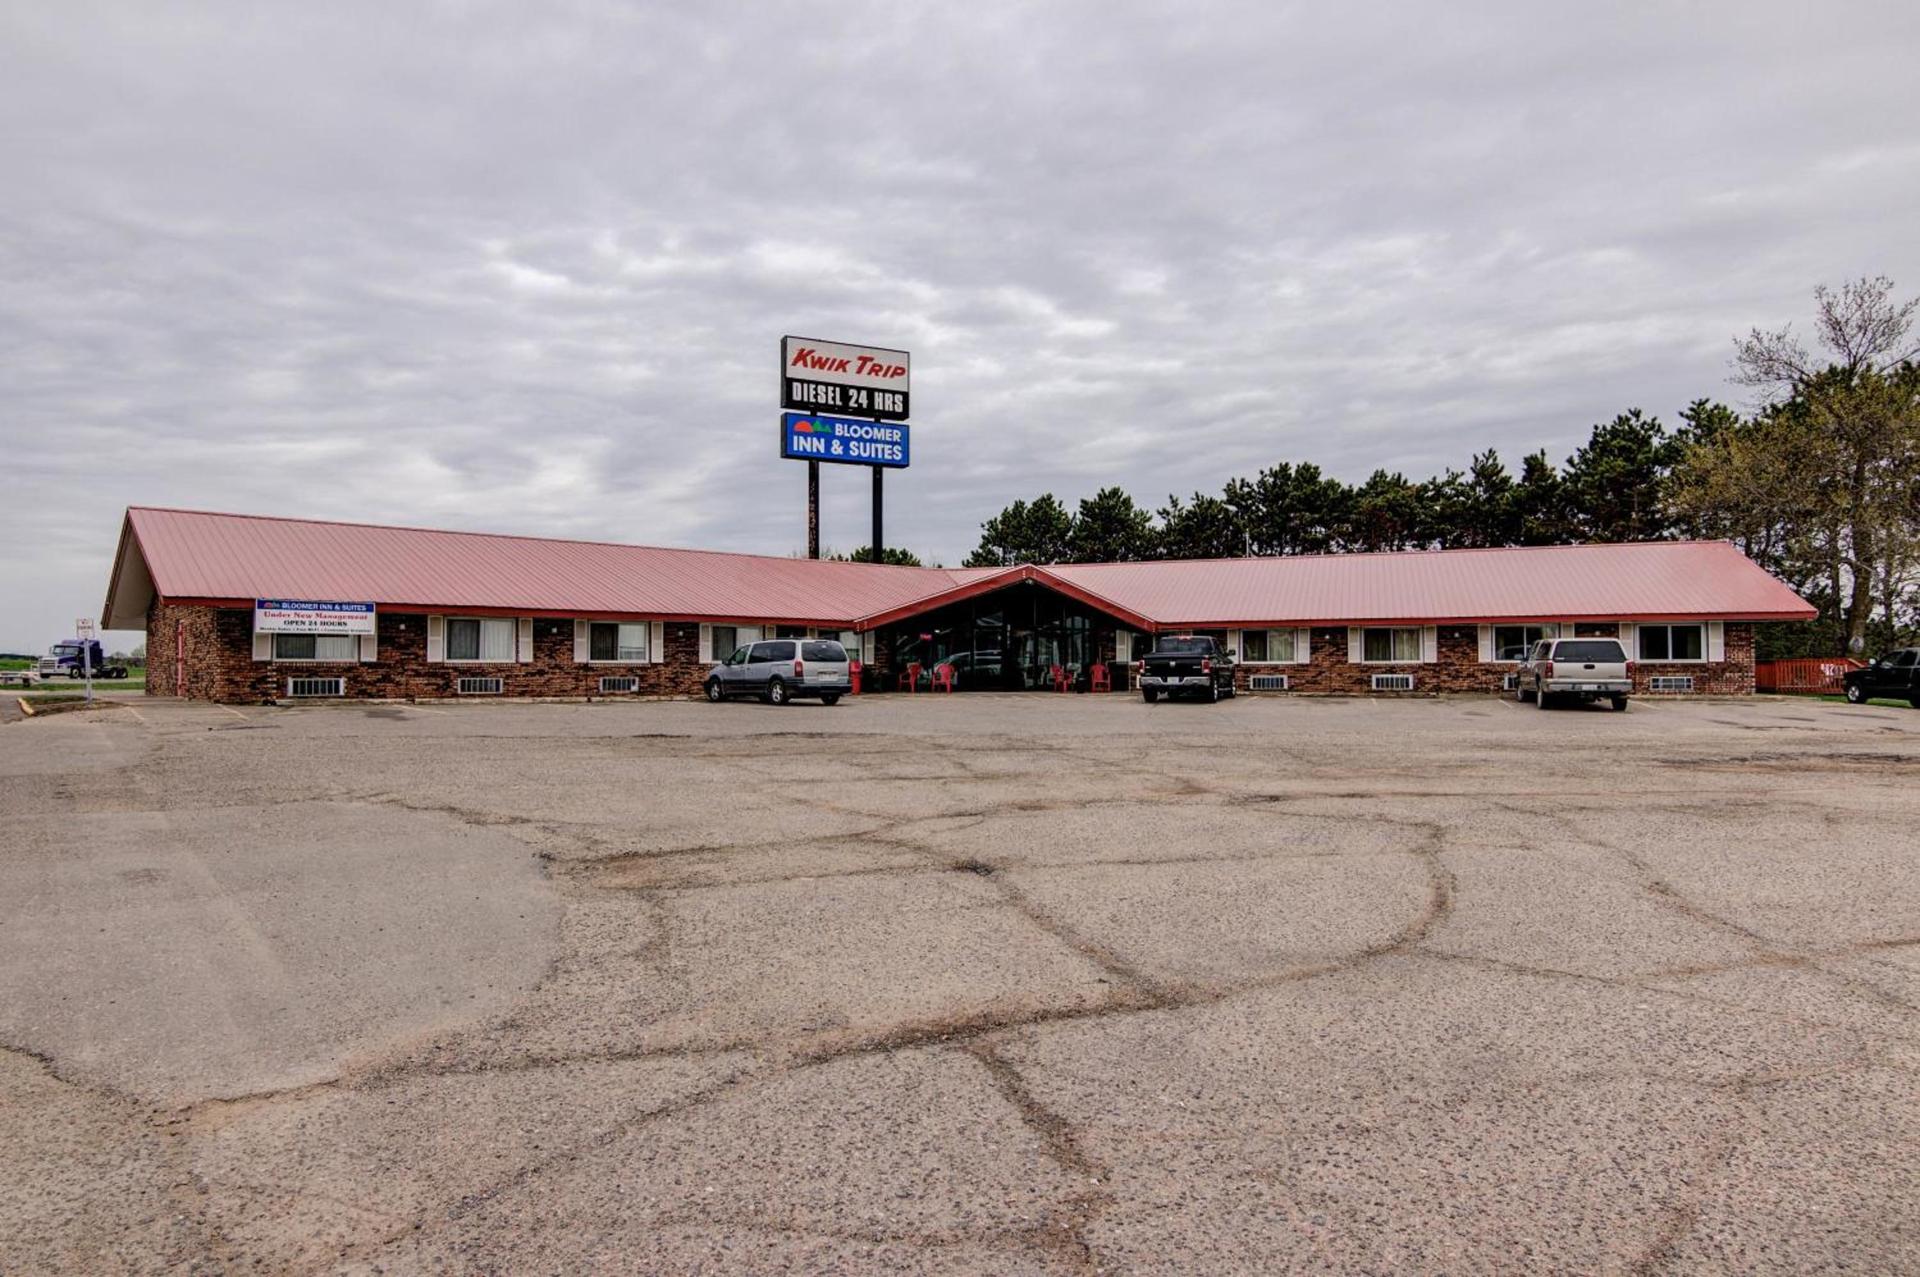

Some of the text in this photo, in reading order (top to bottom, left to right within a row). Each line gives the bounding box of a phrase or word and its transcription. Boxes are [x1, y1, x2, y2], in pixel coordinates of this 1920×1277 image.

[791, 348, 906, 378] KWIK TRIP
[792, 381, 903, 413] DIESEL 24 HRS
[834, 423, 901, 442] BLOOMER
[793, 435, 902, 460] INN & SUITES
[282, 602, 318, 610] BLOOMER
[315, 612, 368, 620] Management
